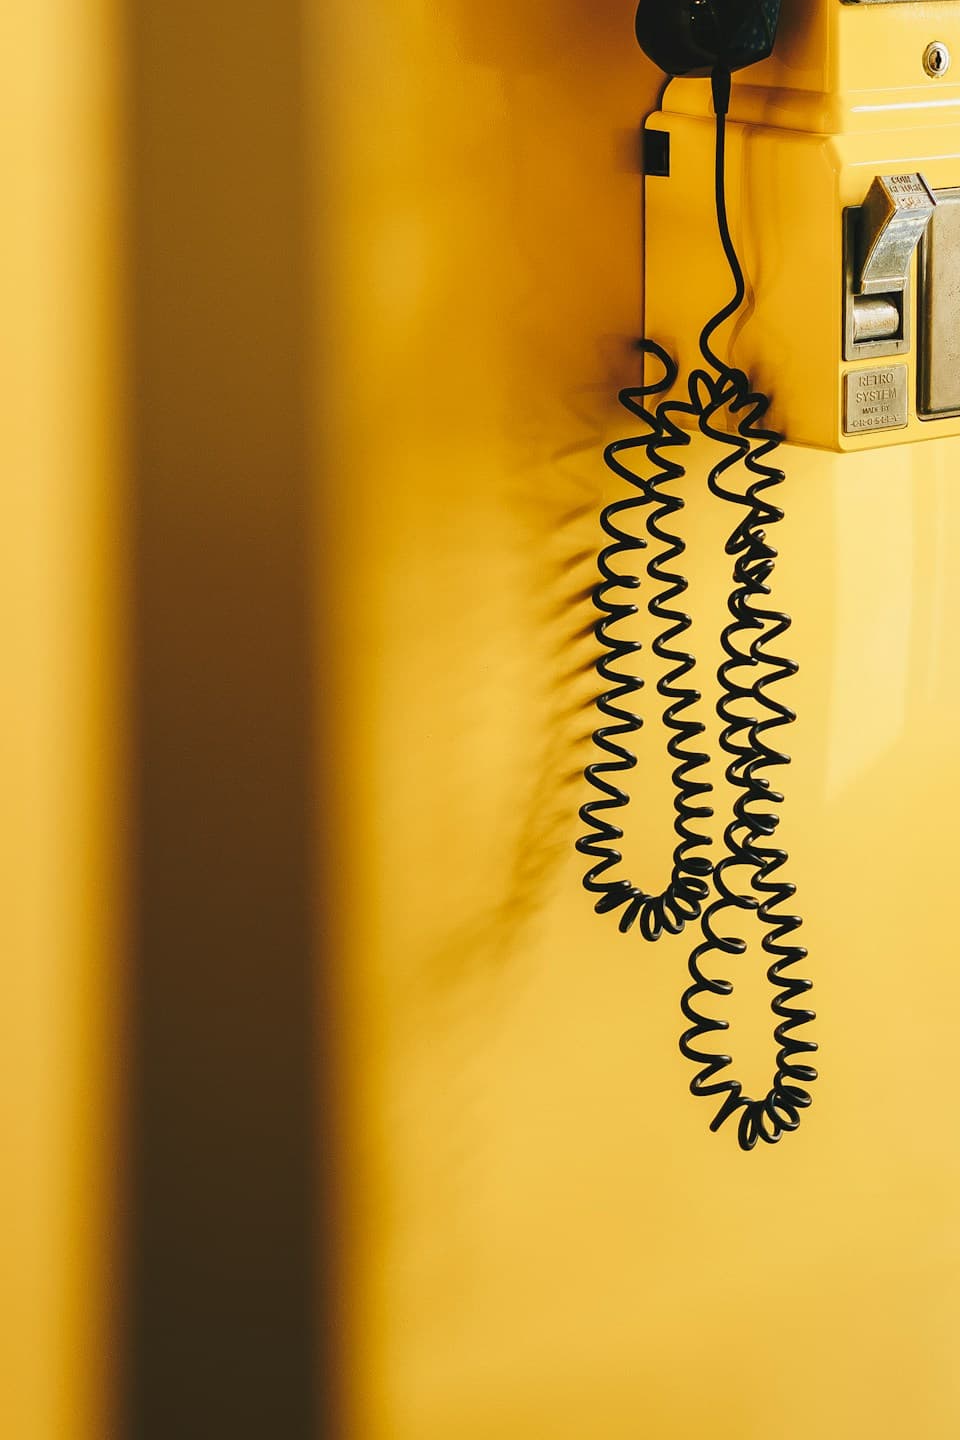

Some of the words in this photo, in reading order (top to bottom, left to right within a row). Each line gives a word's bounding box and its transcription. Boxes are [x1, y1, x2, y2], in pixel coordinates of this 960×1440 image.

[859, 372, 894, 387] RETRO
[855, 387, 897, 403] SYSTEM
[862, 406, 879, 414] MADE
